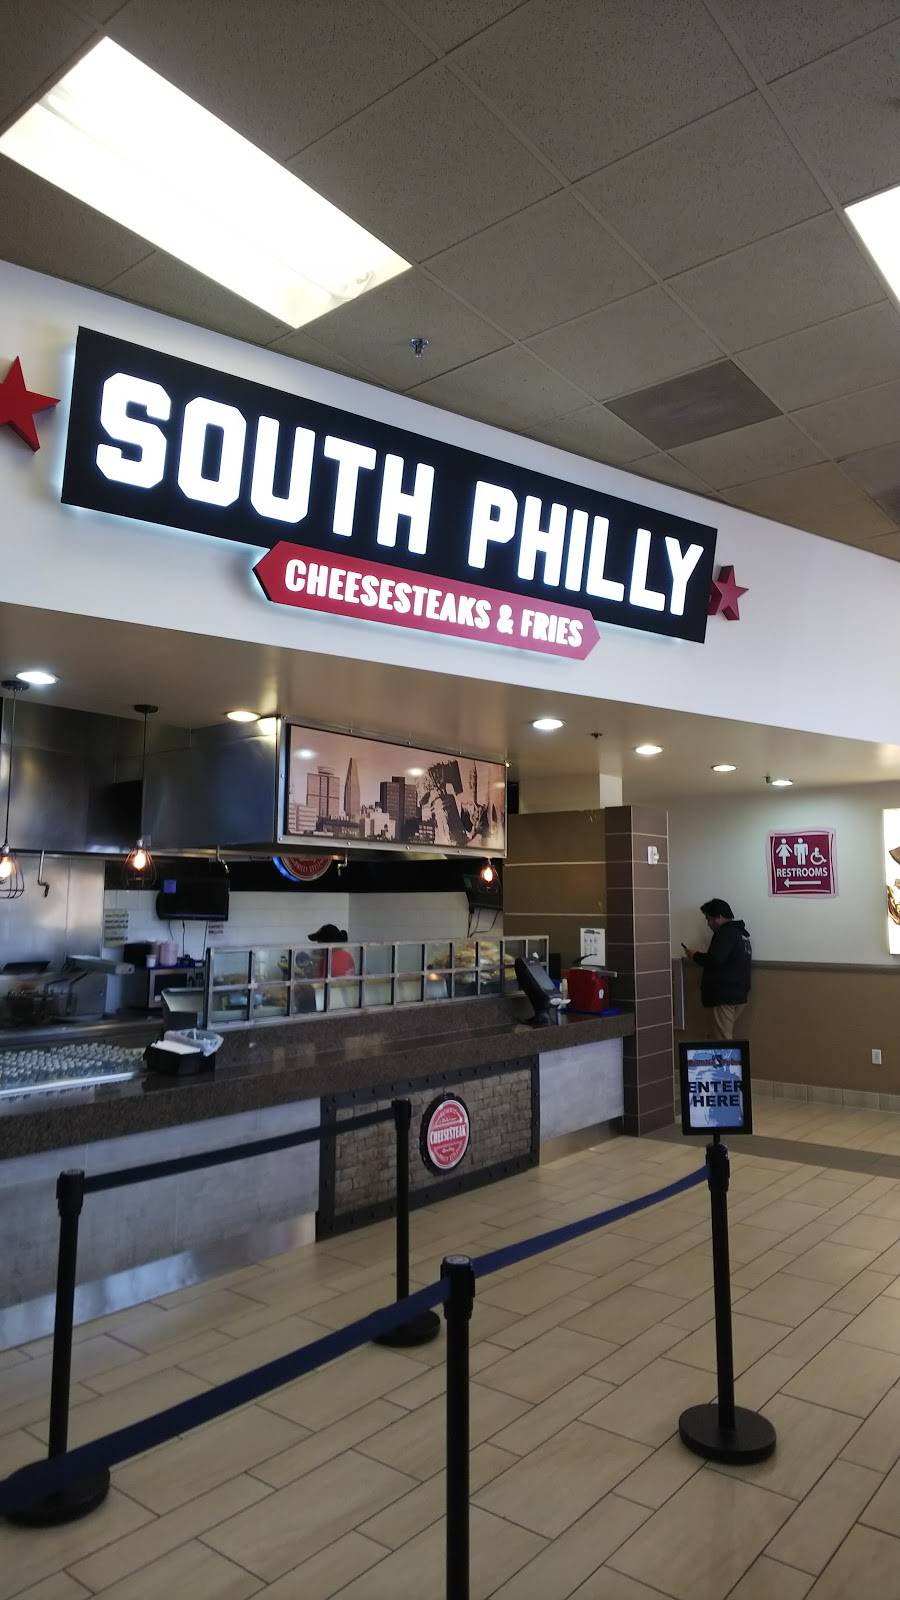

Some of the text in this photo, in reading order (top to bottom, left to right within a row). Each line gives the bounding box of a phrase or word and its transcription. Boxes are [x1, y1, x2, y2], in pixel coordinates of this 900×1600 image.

[96, 372, 704, 616] SOUTH PHILLY
[284, 559, 584, 647] CHEESESTEAKS & FRIES
[776, 867, 828, 878] RESTROOMS
[688, 1081, 743, 1093] ENTER
[693, 1095, 740, 1107] HERE
[430, 1124, 466, 1145] CHEESESTEAK
